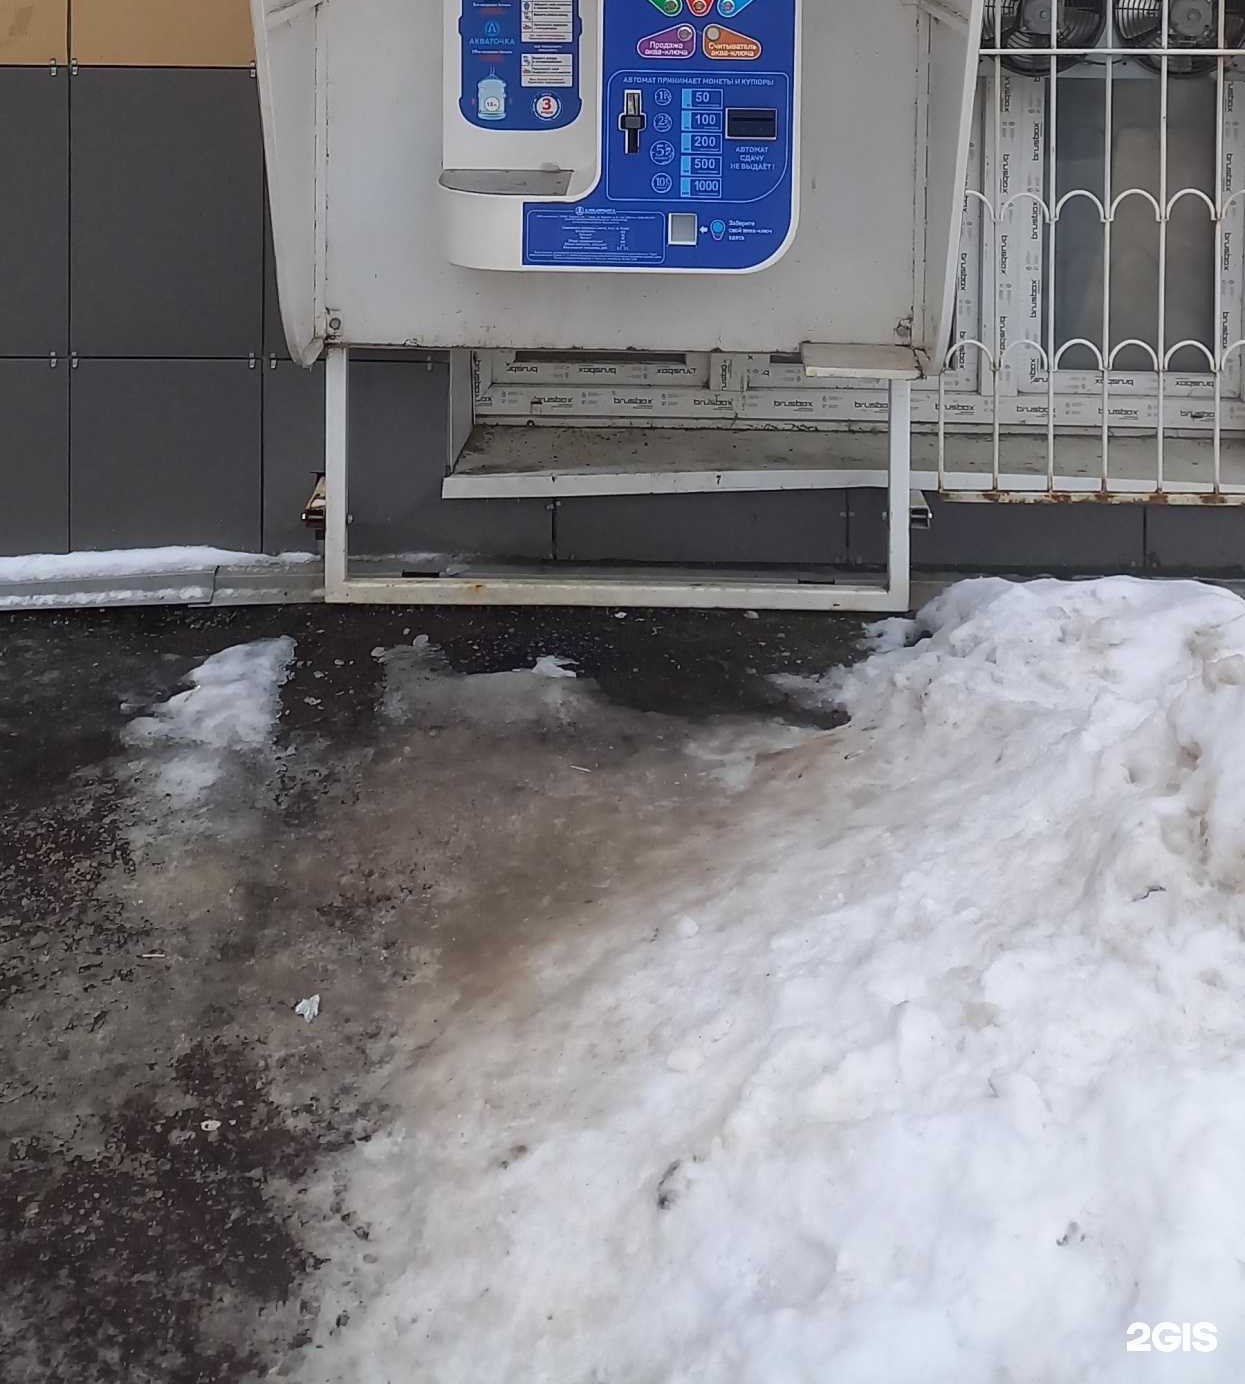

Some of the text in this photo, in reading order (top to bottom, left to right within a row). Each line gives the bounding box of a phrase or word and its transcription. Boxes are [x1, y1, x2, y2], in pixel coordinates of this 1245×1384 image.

[649, 40, 683, 50] Продажа
[623, 76, 656, 84] АВТОМАТ
[657, 77, 701, 85] ПРИНИМАЕТ
[741, 78, 774, 86] КУПЮРЫ
[695, 92, 710, 102] 50
[542, 98, 552, 110] 3
[695, 114, 716, 125] 100
[694, 136, 716, 147] 200
[739, 154, 764, 162] СДАЧУ
[694, 159, 716, 169] 500
[1002, 153, 1010, 194] brusbox
[694, 181, 719, 191] 1000
[959, 331, 967, 368] brsbox
[773, 399, 813, 407] brusbox
[854, 400, 889, 409] brusbo
[935, 403, 976, 411] busbox
[1098, 407, 1139, 415] busbox
[1180, 410, 1215, 418] brusbo
